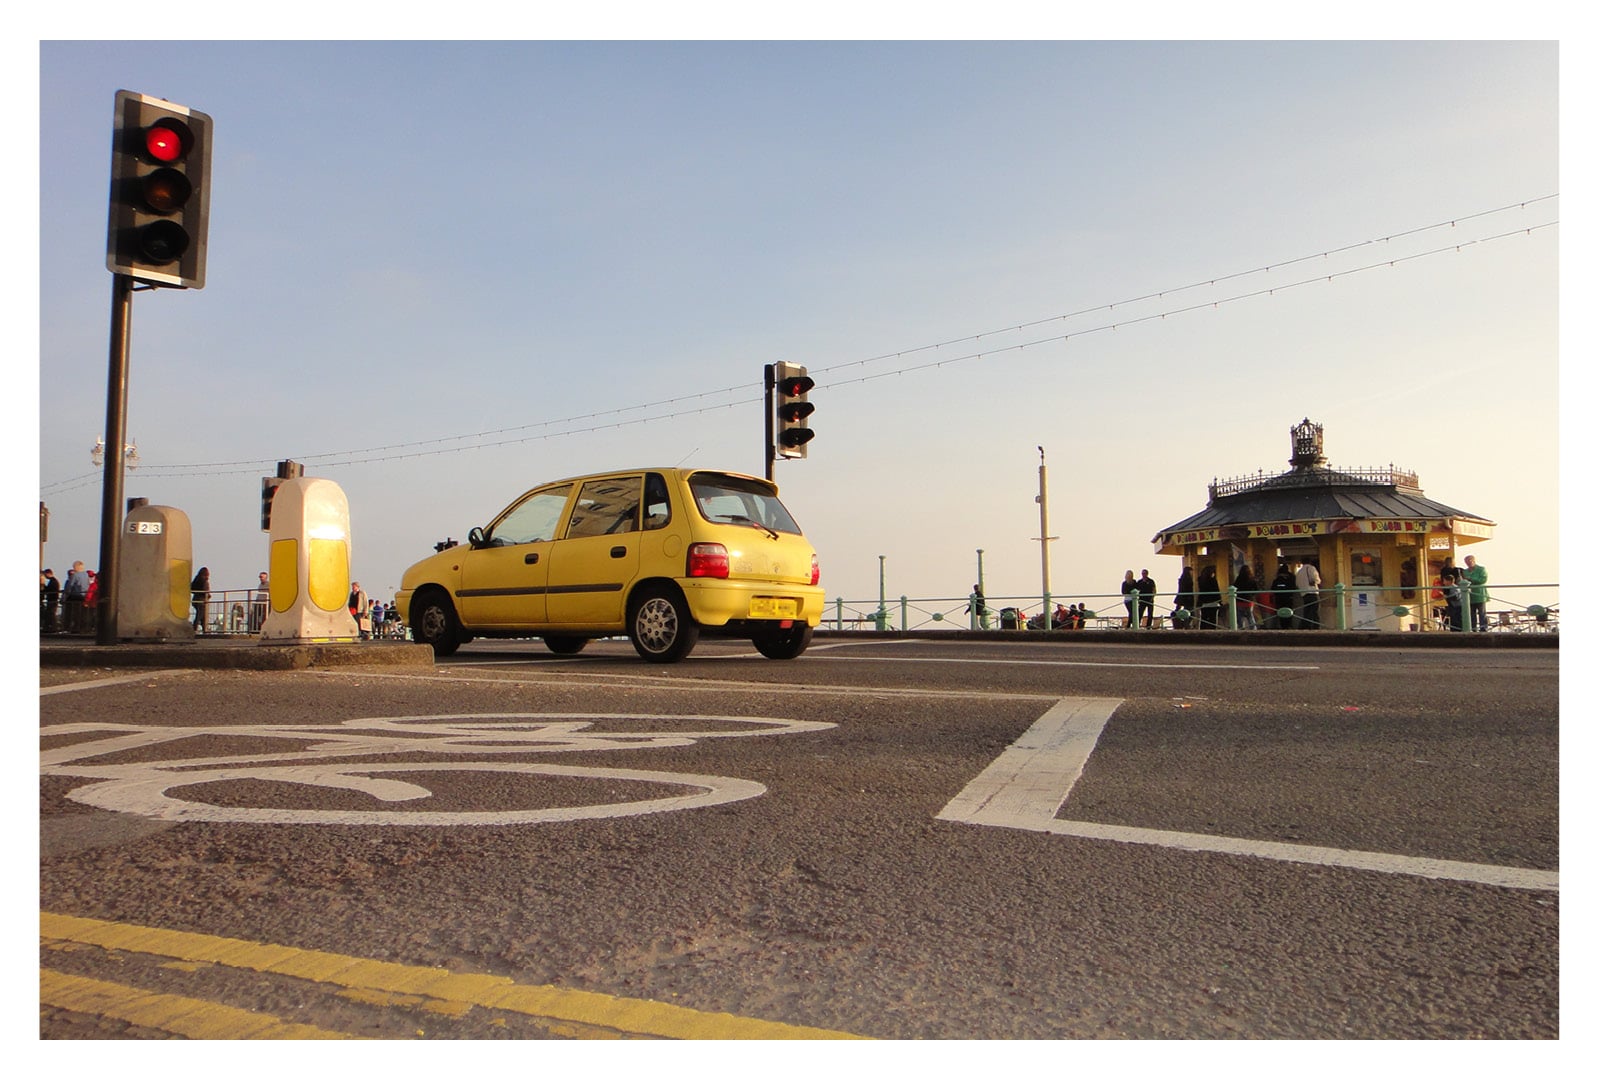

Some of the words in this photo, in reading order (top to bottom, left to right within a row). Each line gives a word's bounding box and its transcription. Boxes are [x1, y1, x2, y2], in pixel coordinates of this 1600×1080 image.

[129, 523, 160, 533] 523
[1292, 522, 1317, 534] NUT
[1405, 521, 1427, 532] NUT
